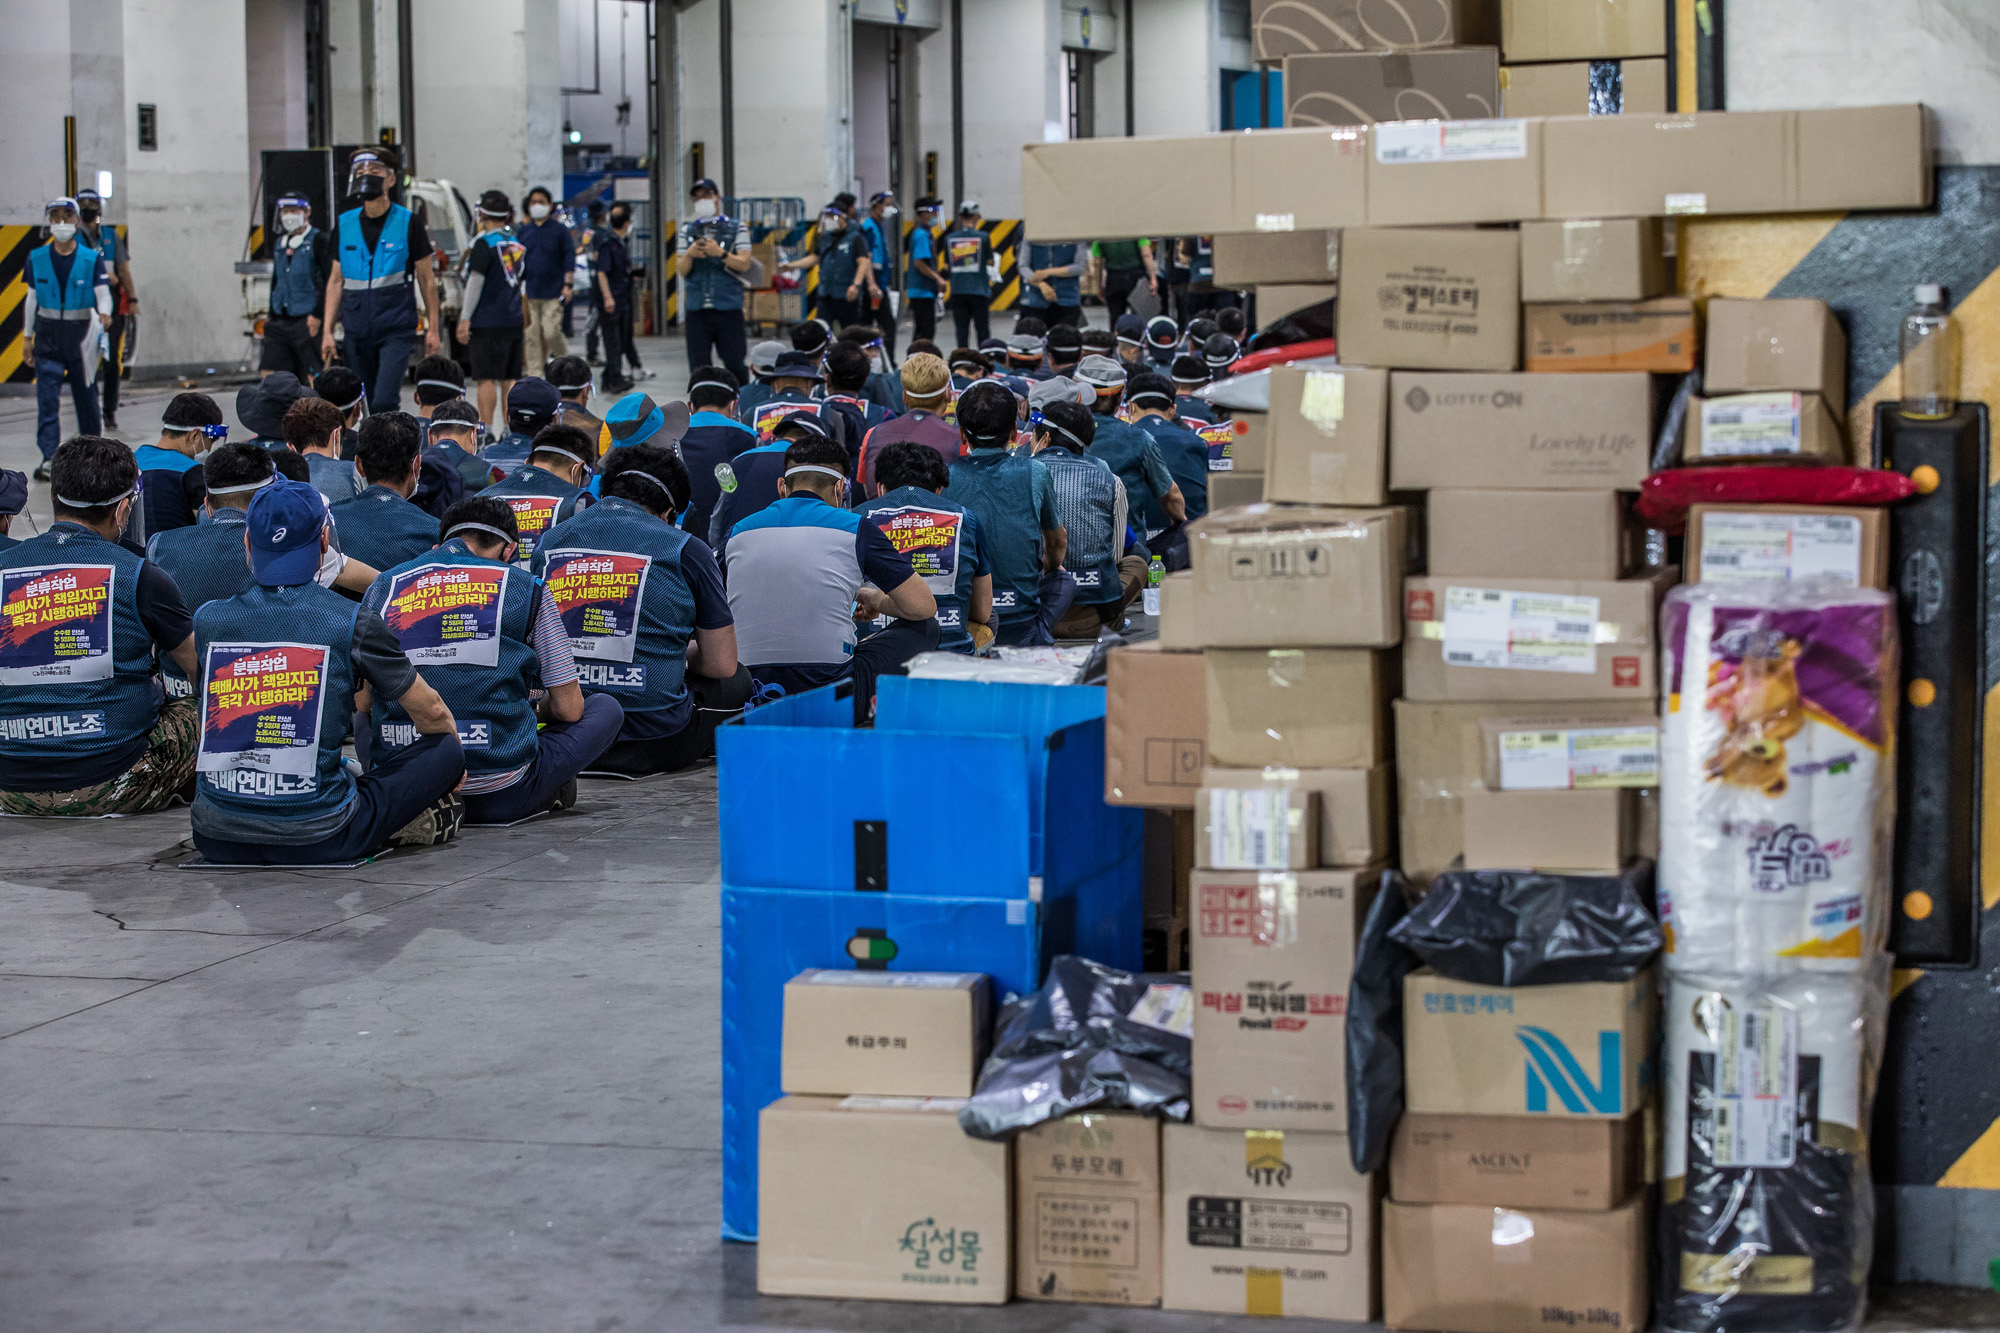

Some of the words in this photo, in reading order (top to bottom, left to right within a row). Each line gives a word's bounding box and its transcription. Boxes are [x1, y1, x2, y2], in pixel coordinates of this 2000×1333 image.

[1436, 394, 1487, 405] LOTTE
[1491, 390, 1523, 409] ON
[1529, 433, 1594, 456] Lovely
[1598, 433, 1637, 456] Life
[566, 559, 614, 575] 분류작업
[26, 574, 77, 597] 분류작업
[417, 571, 469, 589] 분류작업
[590, 573, 639, 586] 책임지고
[3, 595, 51, 616] 택배사가
[54, 586, 107, 605] 책임지고
[391, 585, 441, 607] 택배사가
[444, 582, 499, 594] 책임지고
[400, 599, 426, 613] 즉각
[430, 593, 487, 609] 시행하라!
[576, 586, 628, 600] 시행하라!
[12, 611, 37, 627] 즉각
[40, 602, 97, 622] 시행하라!
[233, 652, 288, 676] 분류작업
[209, 676, 259, 695] 택배사가
[262, 670, 319, 688] 책임지고
[219, 693, 243, 709] 즉각
[247, 687, 307, 706] 시행하라!
[1203, 991, 1242, 1013] 퍼실
[1247, 993, 1306, 1014] 파워젤
[847, 1035, 907, 1049] 취급주의
[1052, 1154, 1123, 1177] 두부모래
